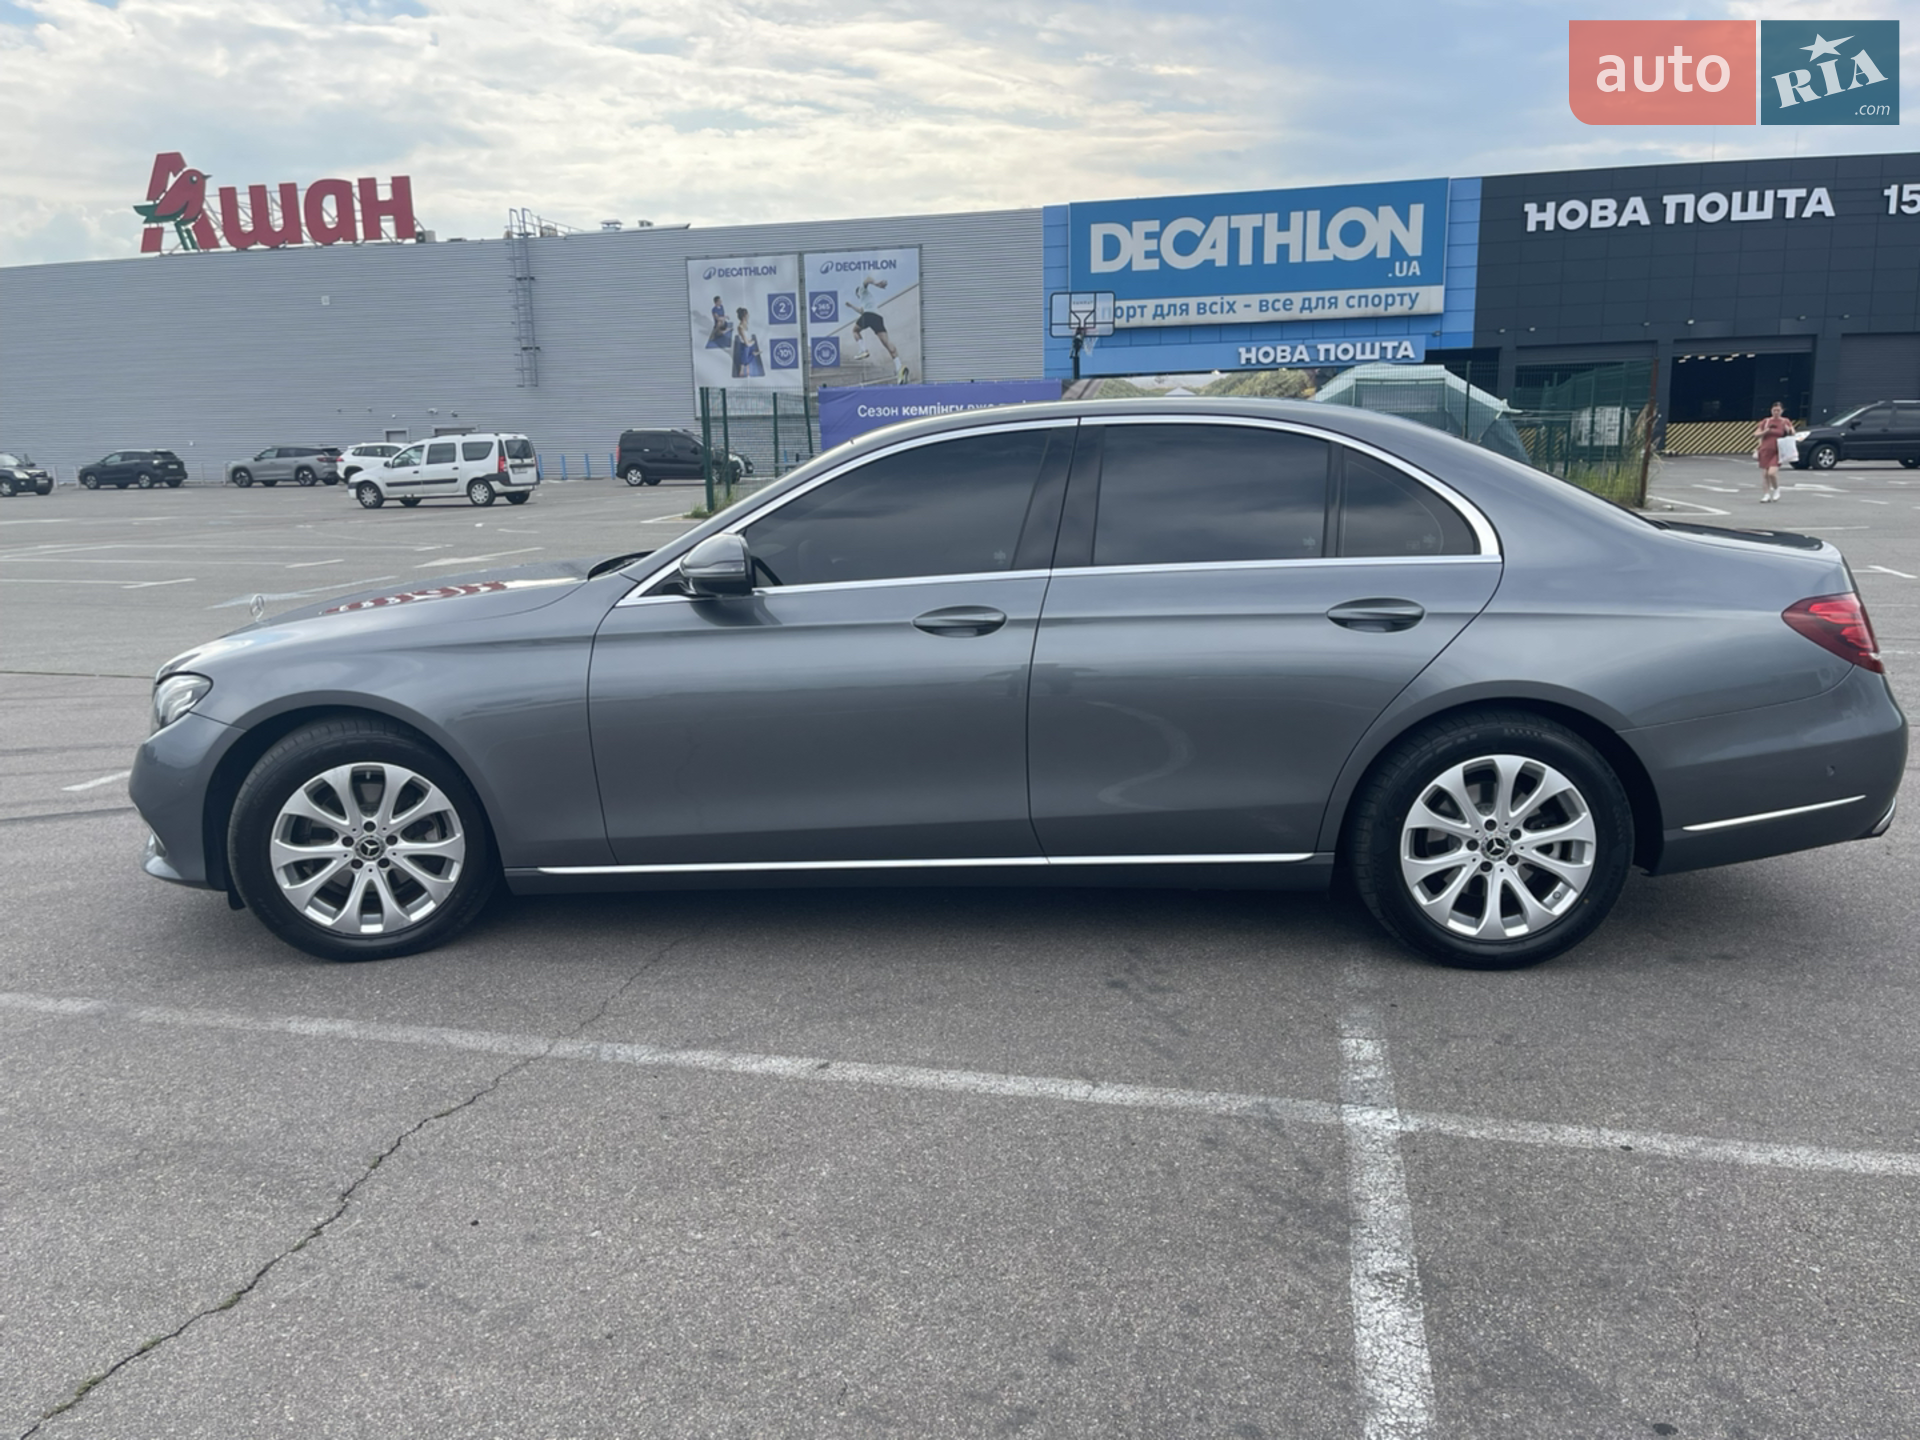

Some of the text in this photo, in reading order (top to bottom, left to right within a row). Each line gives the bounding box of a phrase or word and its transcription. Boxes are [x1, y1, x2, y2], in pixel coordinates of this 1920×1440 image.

[1524, 196, 1651, 232] НОВА
[1662, 187, 1836, 225] ПОШТА
[1090, 203, 1425, 274] DECATHLON
[717, 265, 777, 278] DECATHLON
[835, 259, 897, 272] DECATHLON
[1387, 260, 1421, 277] .UA
[779, 302, 786, 313] 2
[1152, 300, 1190, 320] для
[1196, 296, 1237, 315] всіх
[1259, 295, 1294, 313] все
[1299, 292, 1339, 314] для
[1345, 290, 1420, 311] спорту
[1238, 340, 1416, 366] НОВА ПОШТА
[857, 404, 899, 418] Сезон
